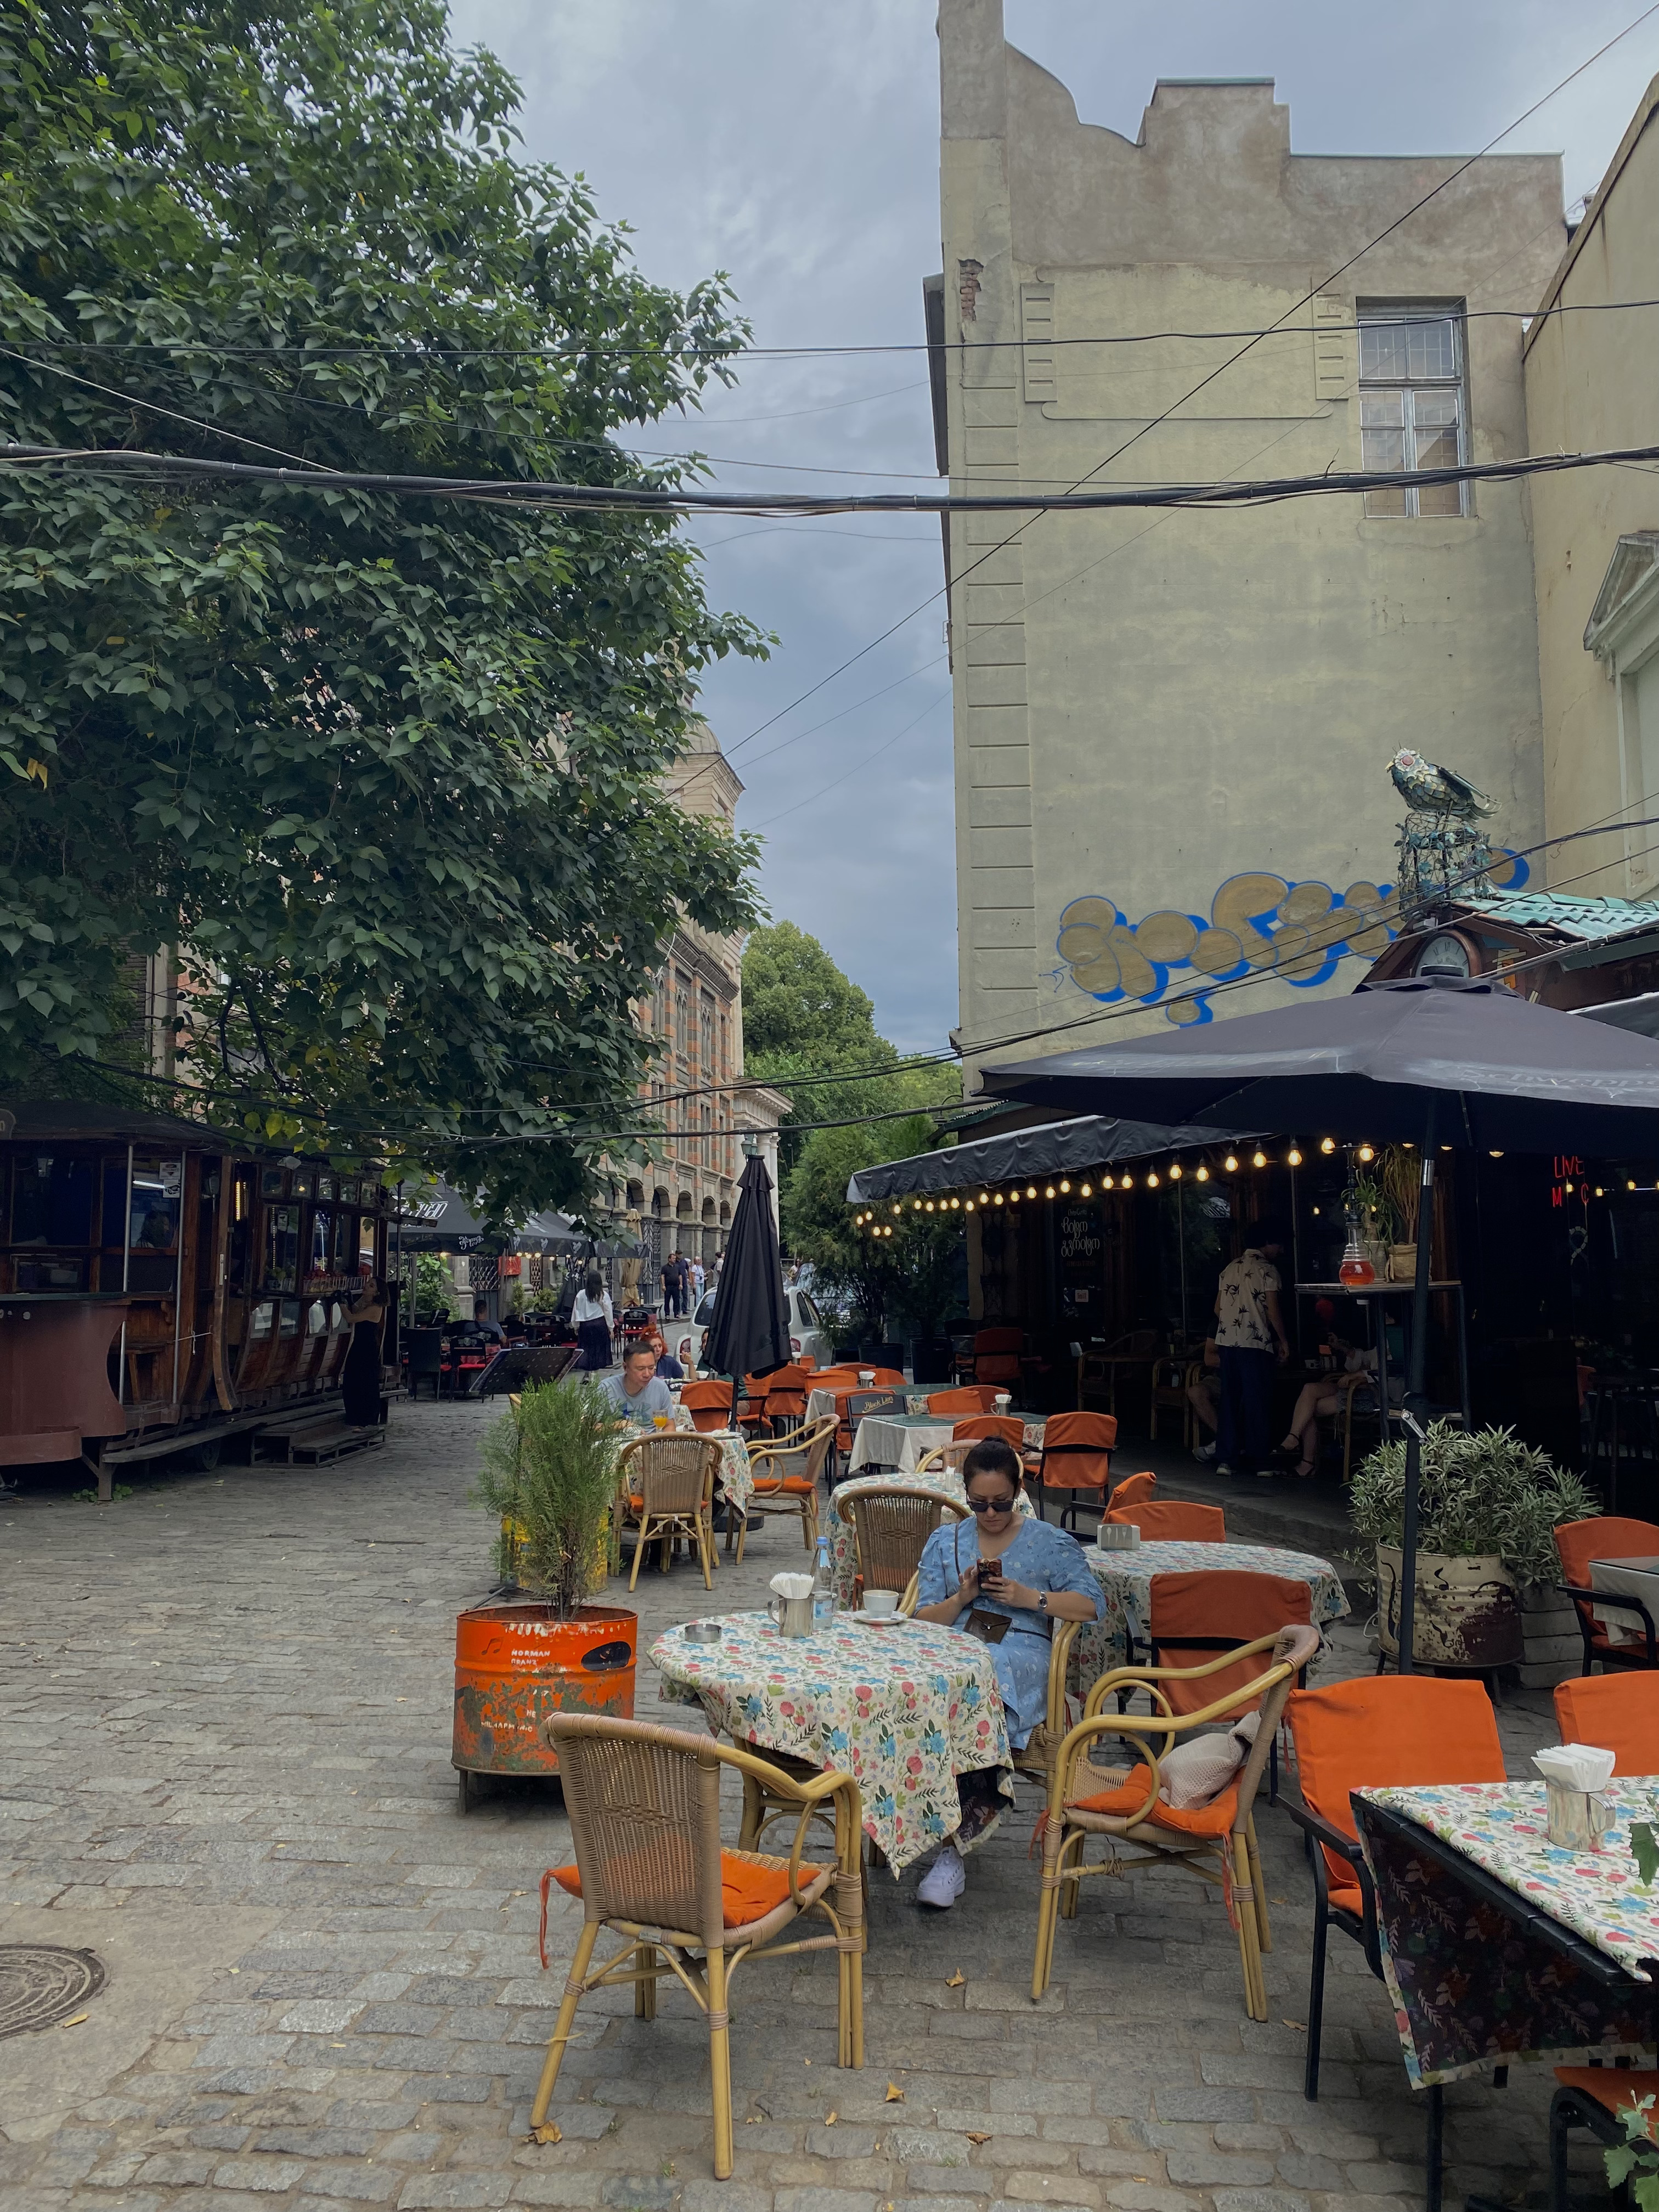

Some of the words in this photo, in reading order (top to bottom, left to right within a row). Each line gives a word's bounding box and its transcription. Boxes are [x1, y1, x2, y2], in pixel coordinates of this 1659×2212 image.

[1554, 1155, 1585, 1178] LIVE
[864, 1399, 881, 1410] Black
[881, 1396, 893, 1404] Lion
[511, 1649, 550, 1657] NORMAN
